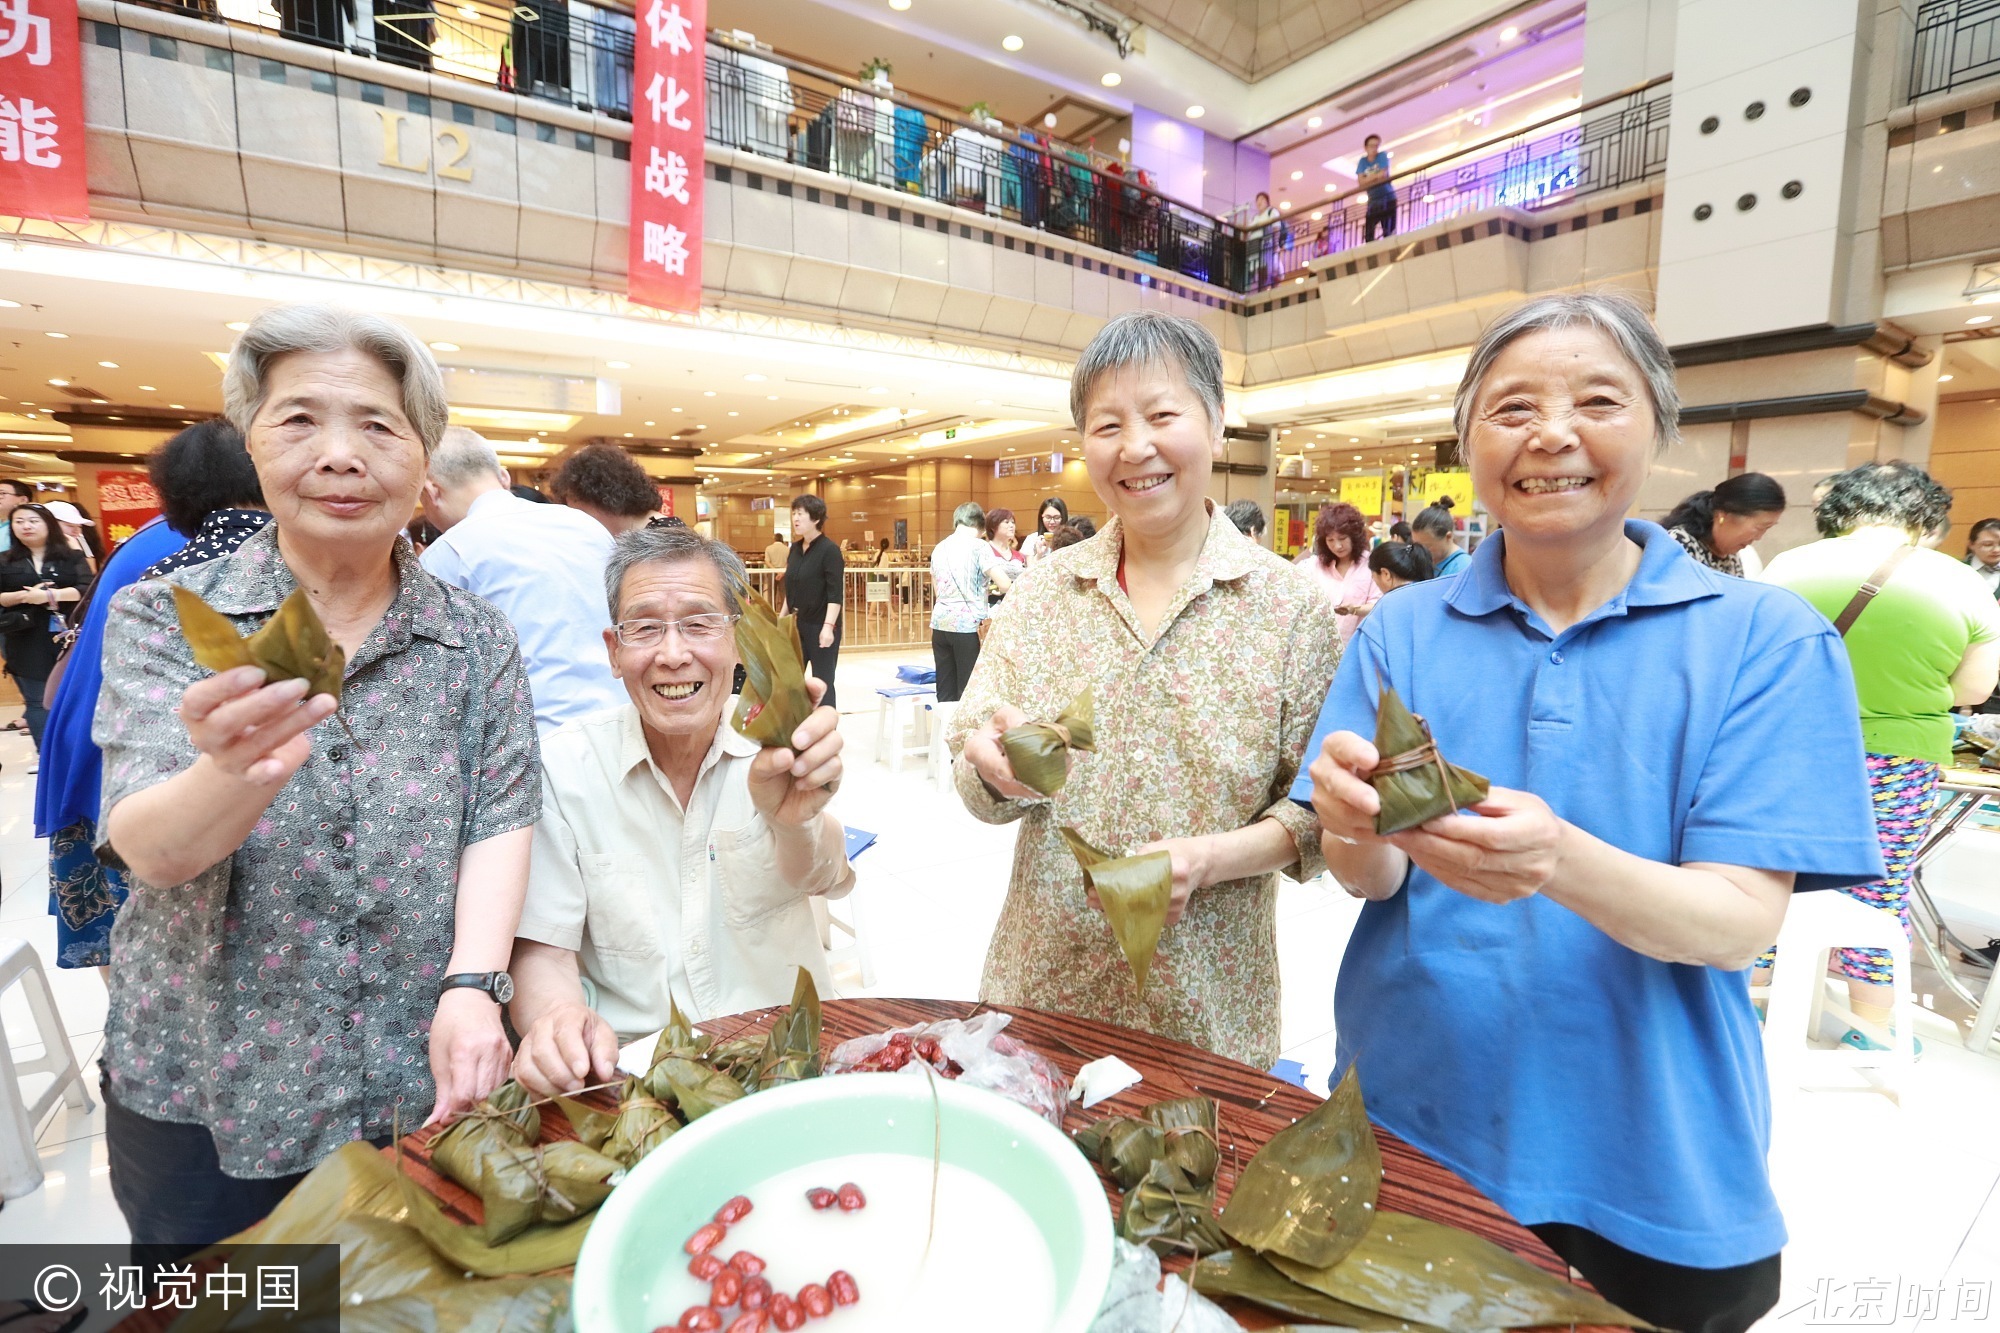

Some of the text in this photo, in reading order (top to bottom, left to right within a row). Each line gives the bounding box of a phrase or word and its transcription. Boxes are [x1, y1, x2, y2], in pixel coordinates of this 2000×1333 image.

[375, 109, 475, 183] L2
[643, 0, 693, 277] 体化战略
